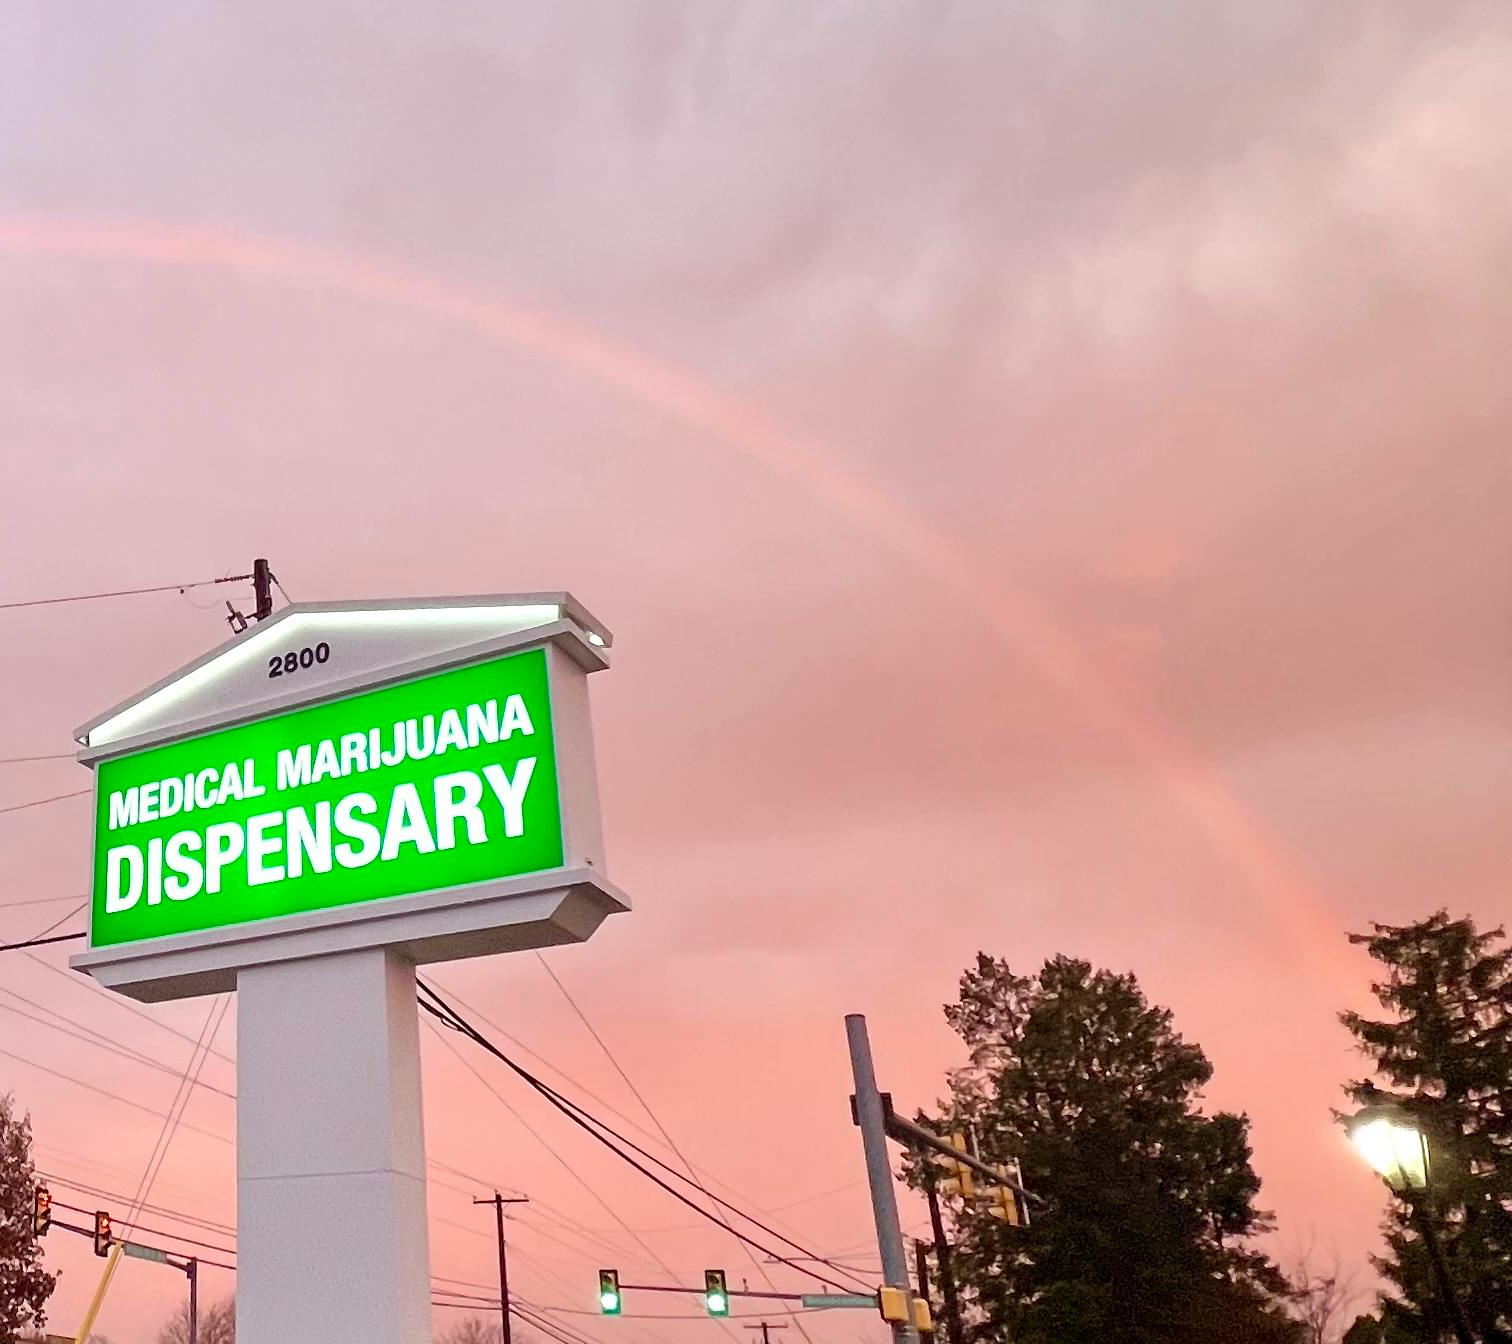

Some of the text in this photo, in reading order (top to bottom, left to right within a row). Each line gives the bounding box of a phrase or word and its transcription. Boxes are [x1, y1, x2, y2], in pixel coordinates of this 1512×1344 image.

[268, 642, 330, 678] 2800
[108, 693, 535, 830] MEDICAL MARIJUANA
[105, 757, 537, 914] DISPENSARY
